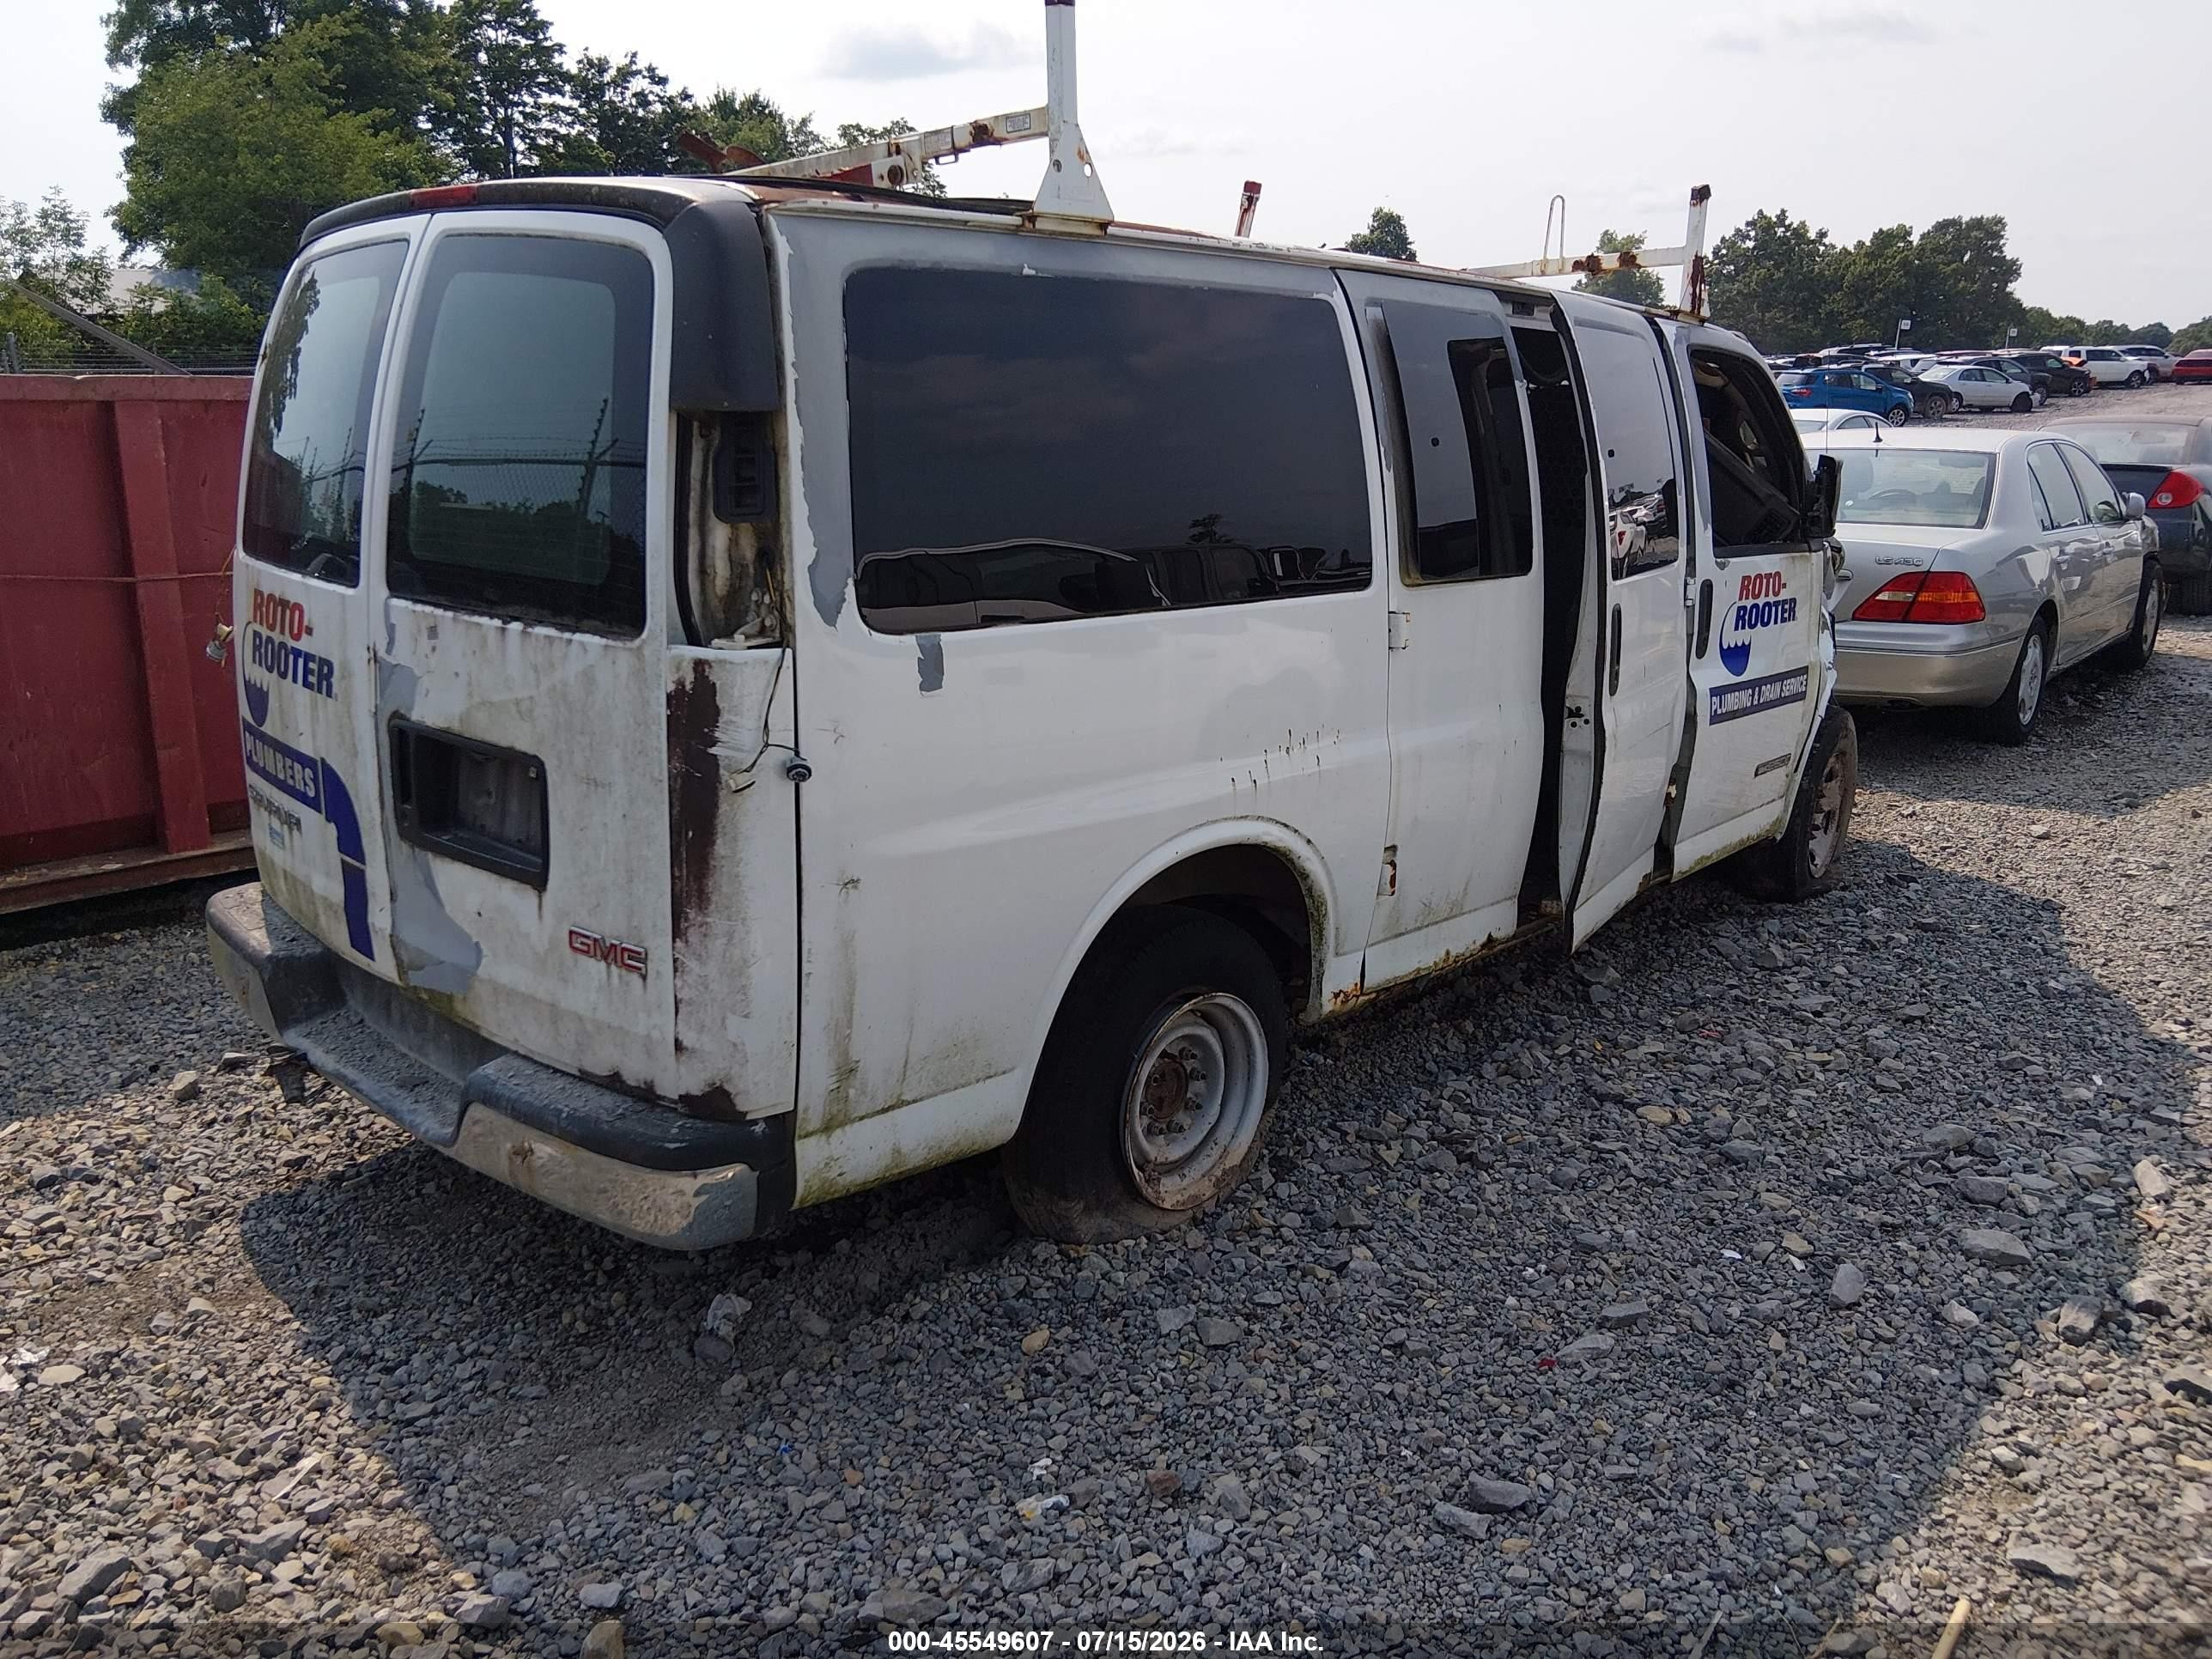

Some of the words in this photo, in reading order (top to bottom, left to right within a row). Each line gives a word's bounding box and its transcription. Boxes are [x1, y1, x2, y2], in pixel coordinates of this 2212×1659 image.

[1875, 556, 1893, 565] LS
[1894, 557, 1923, 567] 430
[1738, 571, 1786, 601] ROTO-
[252, 587, 313, 642] ROTO-
[1734, 597, 1797, 631] ROOTER
[252, 629, 335, 699] ROOTER
[1711, 688, 1753, 716] PLUMBING
[1753, 687, 1759, 706] &
[1759, 681, 1782, 704] DRAIN
[1781, 674, 1807, 698] SERVICE
[244, 731, 316, 798] PLUMBERS
[568, 926, 647, 975] GMC
